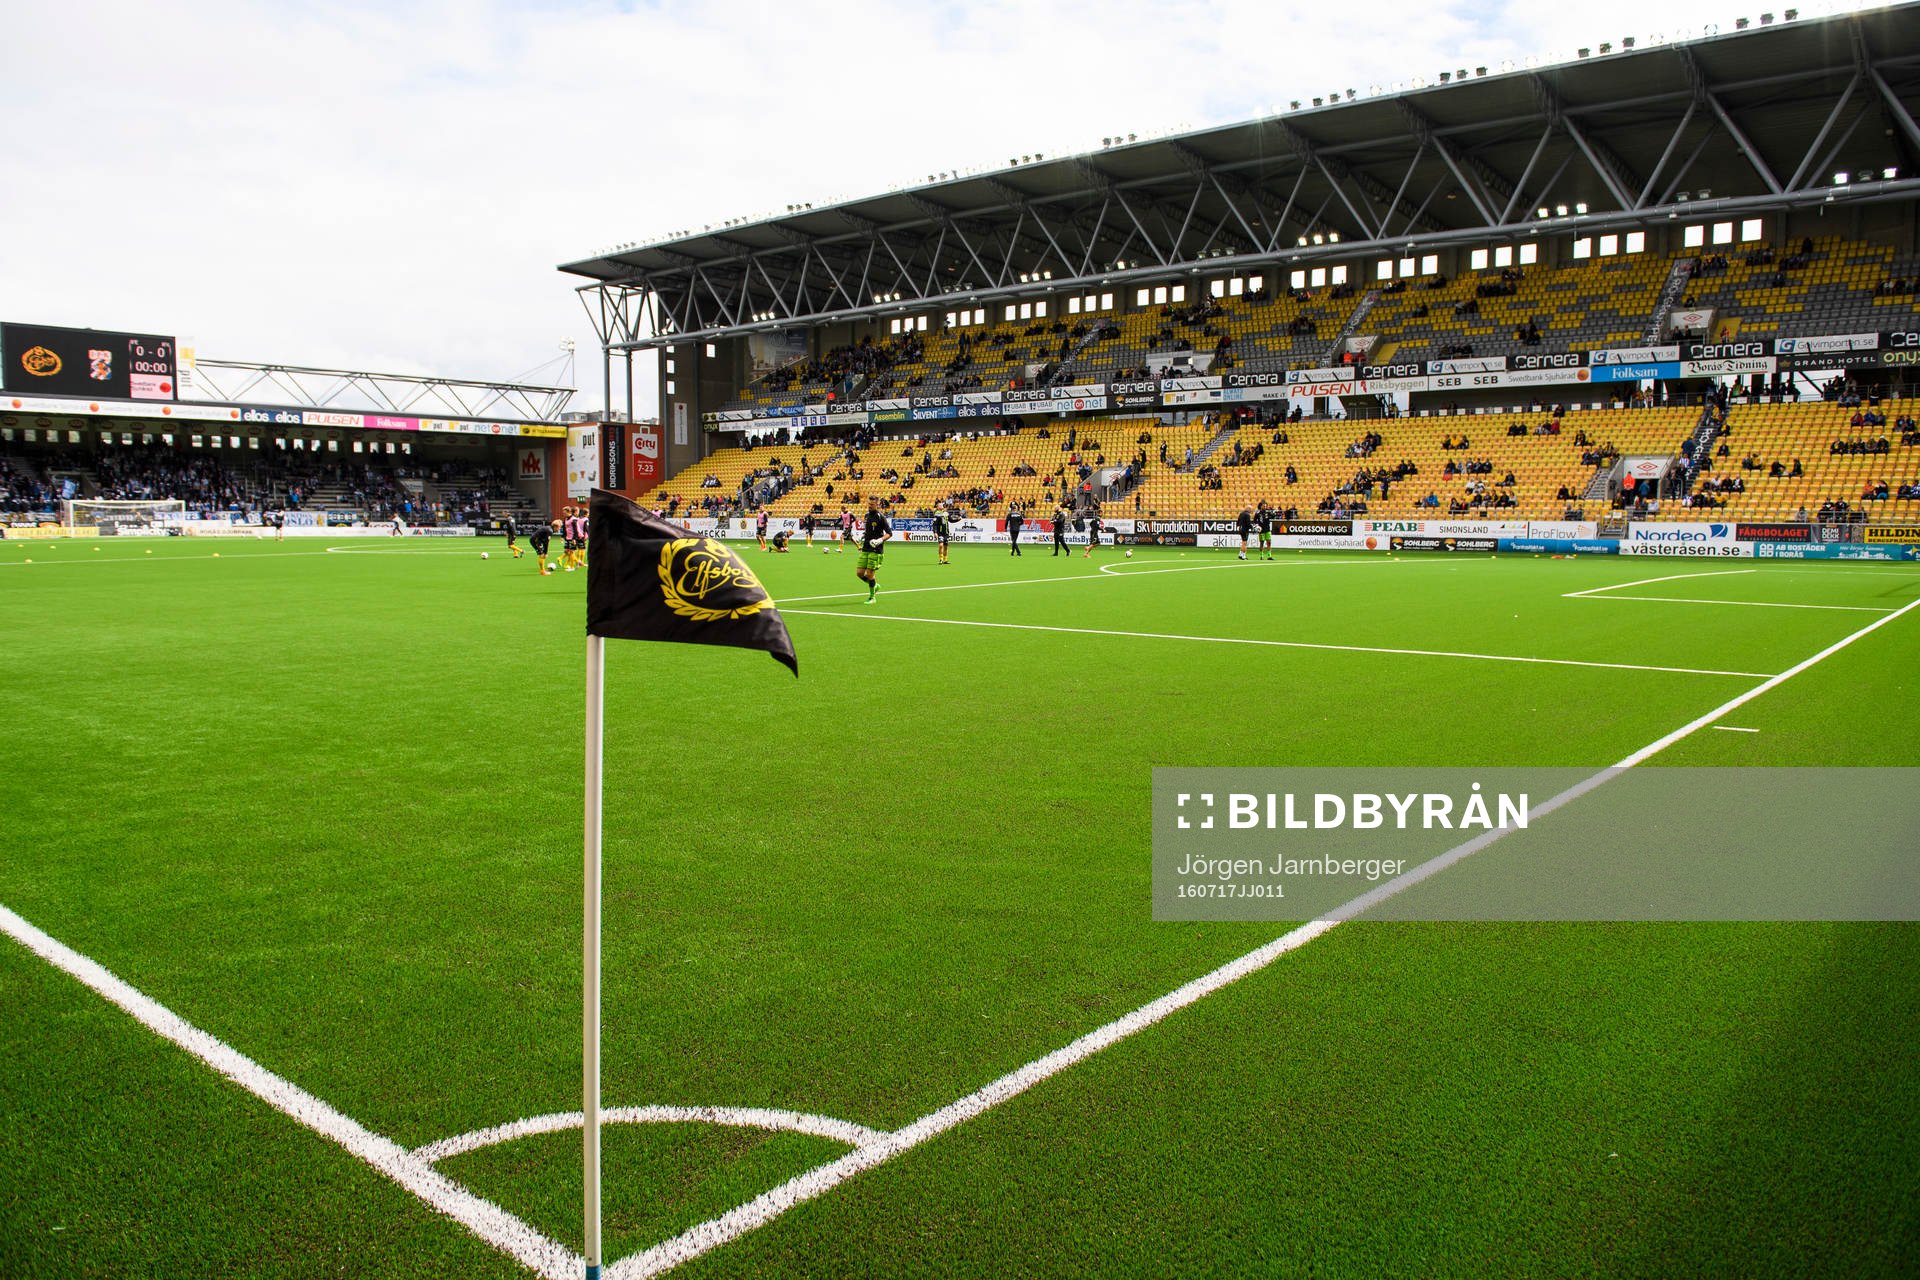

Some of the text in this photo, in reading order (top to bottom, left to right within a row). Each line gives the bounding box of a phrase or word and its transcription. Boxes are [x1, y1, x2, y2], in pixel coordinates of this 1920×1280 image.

[136, 345, 144, 356] 0
[157, 347, 165, 358] 0
[1690, 342, 1763, 359] Cernera
[1515, 353, 1579, 368] Cernera
[135, 361, 167, 373] 00:00
[1362, 364, 1419, 378] Cernera
[1612, 367, 1658, 379] Folksam
[1229, 373, 1278, 386] Cernera
[1438, 378, 1462, 387] SEB
[1473, 375, 1499, 385] SEB
[1508, 371, 1577, 384] Swedbank Sjuhärad
[1111, 382, 1155, 394] Cernera
[1291, 383, 1352, 397] PULSEN
[1370, 379, 1424, 391] Riksbyggen
[913, 396, 949, 407] Cernera
[1006, 390, 1046, 401] Cernera
[243, 409, 269, 422] ellos
[873, 412, 905, 420] Assemblin
[913, 410, 938, 420] SILVENT
[958, 405, 976, 416] ellos
[981, 404, 1000, 416] ellos
[275, 411, 300, 423] ellos
[307, 415, 360, 425] PULSEN
[376, 418, 407, 429] Folksam
[583, 432, 596, 448] put
[635, 437, 656, 450] City
[637, 464, 654, 473] 7-23
[1372, 523, 1418, 531] PEAB
[1739, 526, 1808, 537] FÄRGBOLAGET
[1531, 529, 1576, 538] ProFlow
[1636, 530, 1706, 540] Nordea
[1212, 536, 1228, 547] aki
[1299, 536, 1332, 546] Swedbank
[1631, 542, 1740, 556] västeråsen.se
